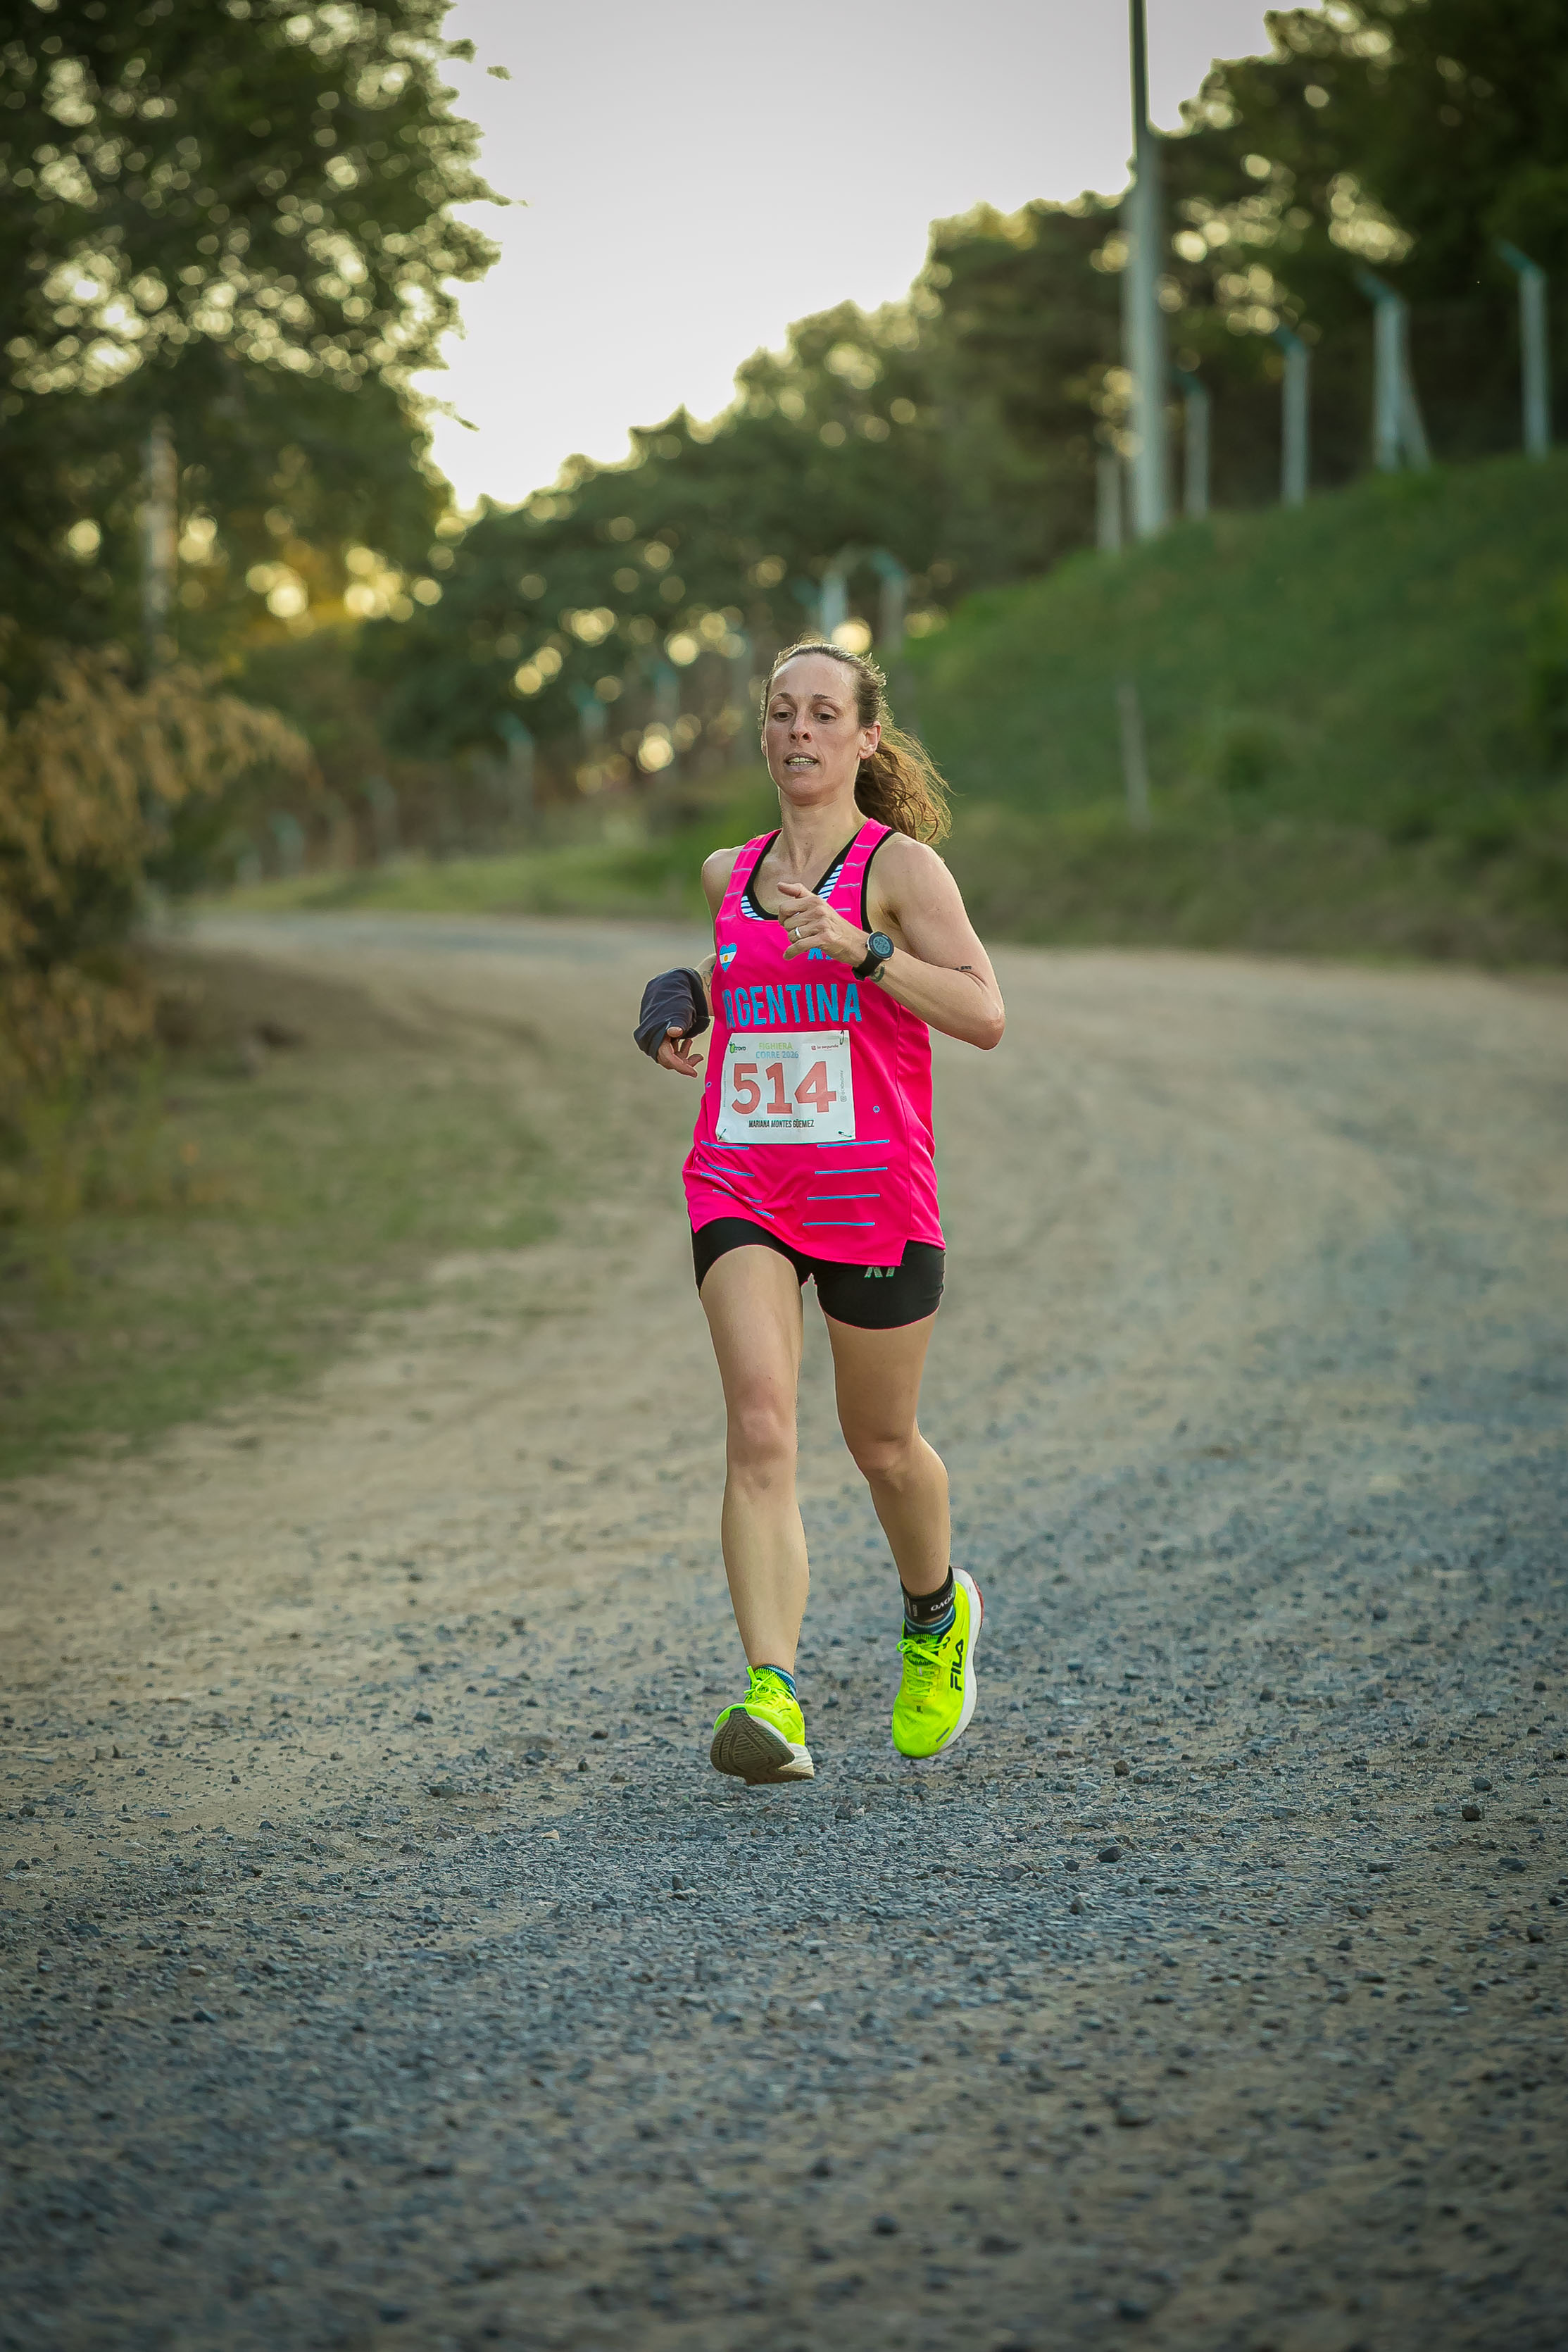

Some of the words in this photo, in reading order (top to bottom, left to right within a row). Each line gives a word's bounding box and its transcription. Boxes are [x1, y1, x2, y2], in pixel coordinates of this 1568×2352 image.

[755, 1051, 780, 1059] CORRE
[782, 1051, 799, 1059] 2026
[732, 1061, 837, 1115] 514
[748, 1120, 770, 1128] MARIANA
[771, 1120, 792, 1128] MONTES
[950, 1639, 964, 1691] FILA
